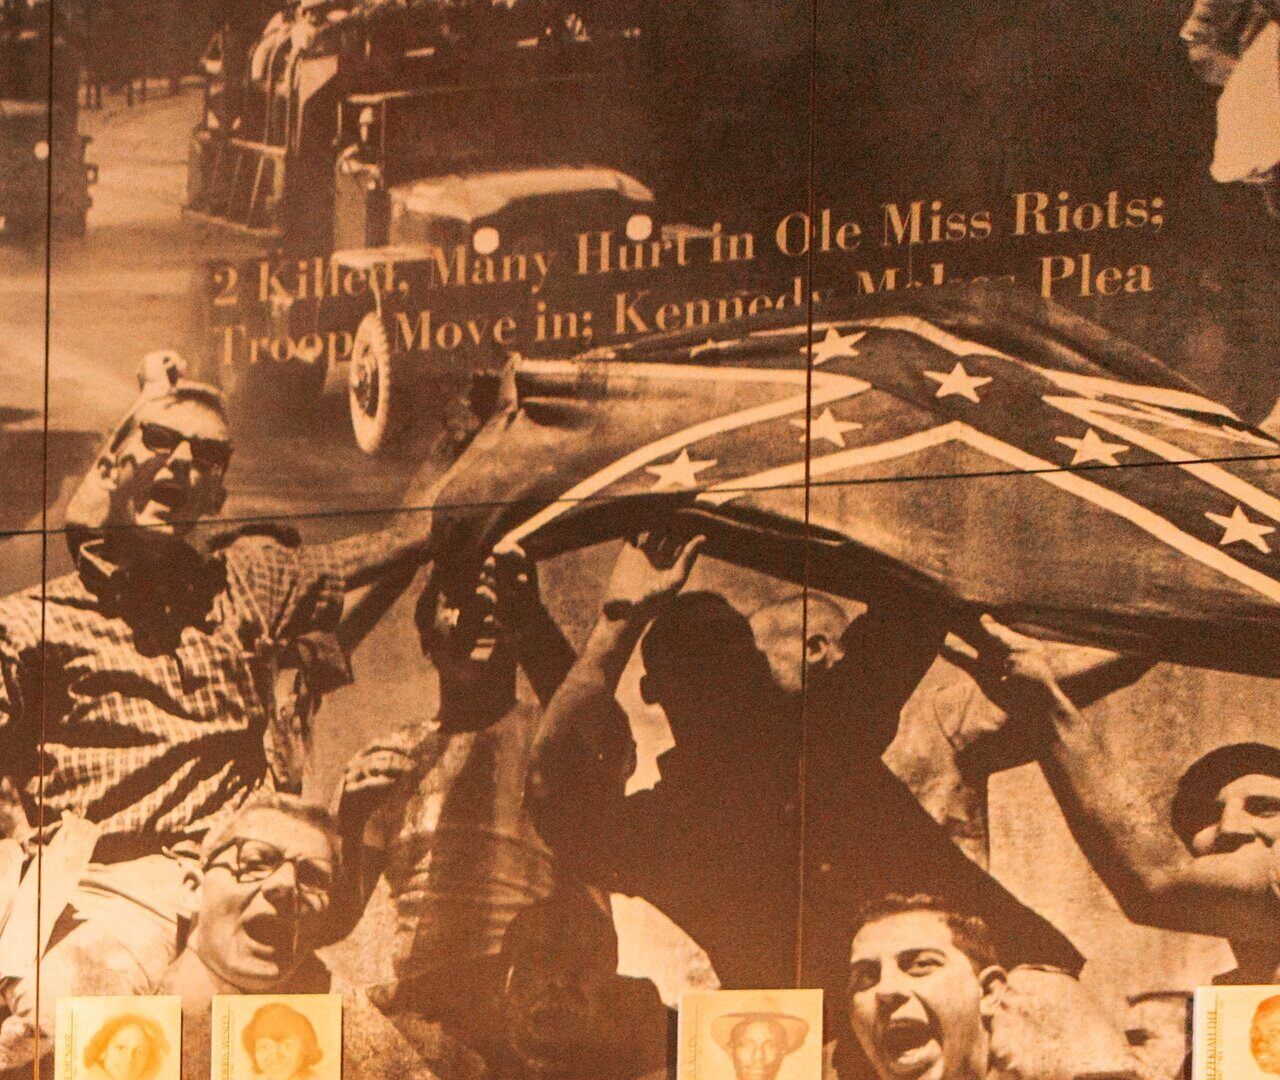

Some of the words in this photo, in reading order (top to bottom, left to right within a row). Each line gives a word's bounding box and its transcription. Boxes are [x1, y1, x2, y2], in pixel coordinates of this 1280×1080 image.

[213, 266, 239, 306] 2
[258, 257, 411, 302] Killed,
[431, 244, 558, 294] Many
[575, 228, 689, 276] Hurt
[711, 221, 756, 263] in
[775, 208, 864, 258] Ole
[881, 200, 994, 248] Miss
[1010, 190, 1166, 238] Riots;
[212, 324, 358, 374] Troop
[393, 311, 519, 353] Move
[536, 300, 596, 345] in;
[1040, 252, 1155, 301] Plea
